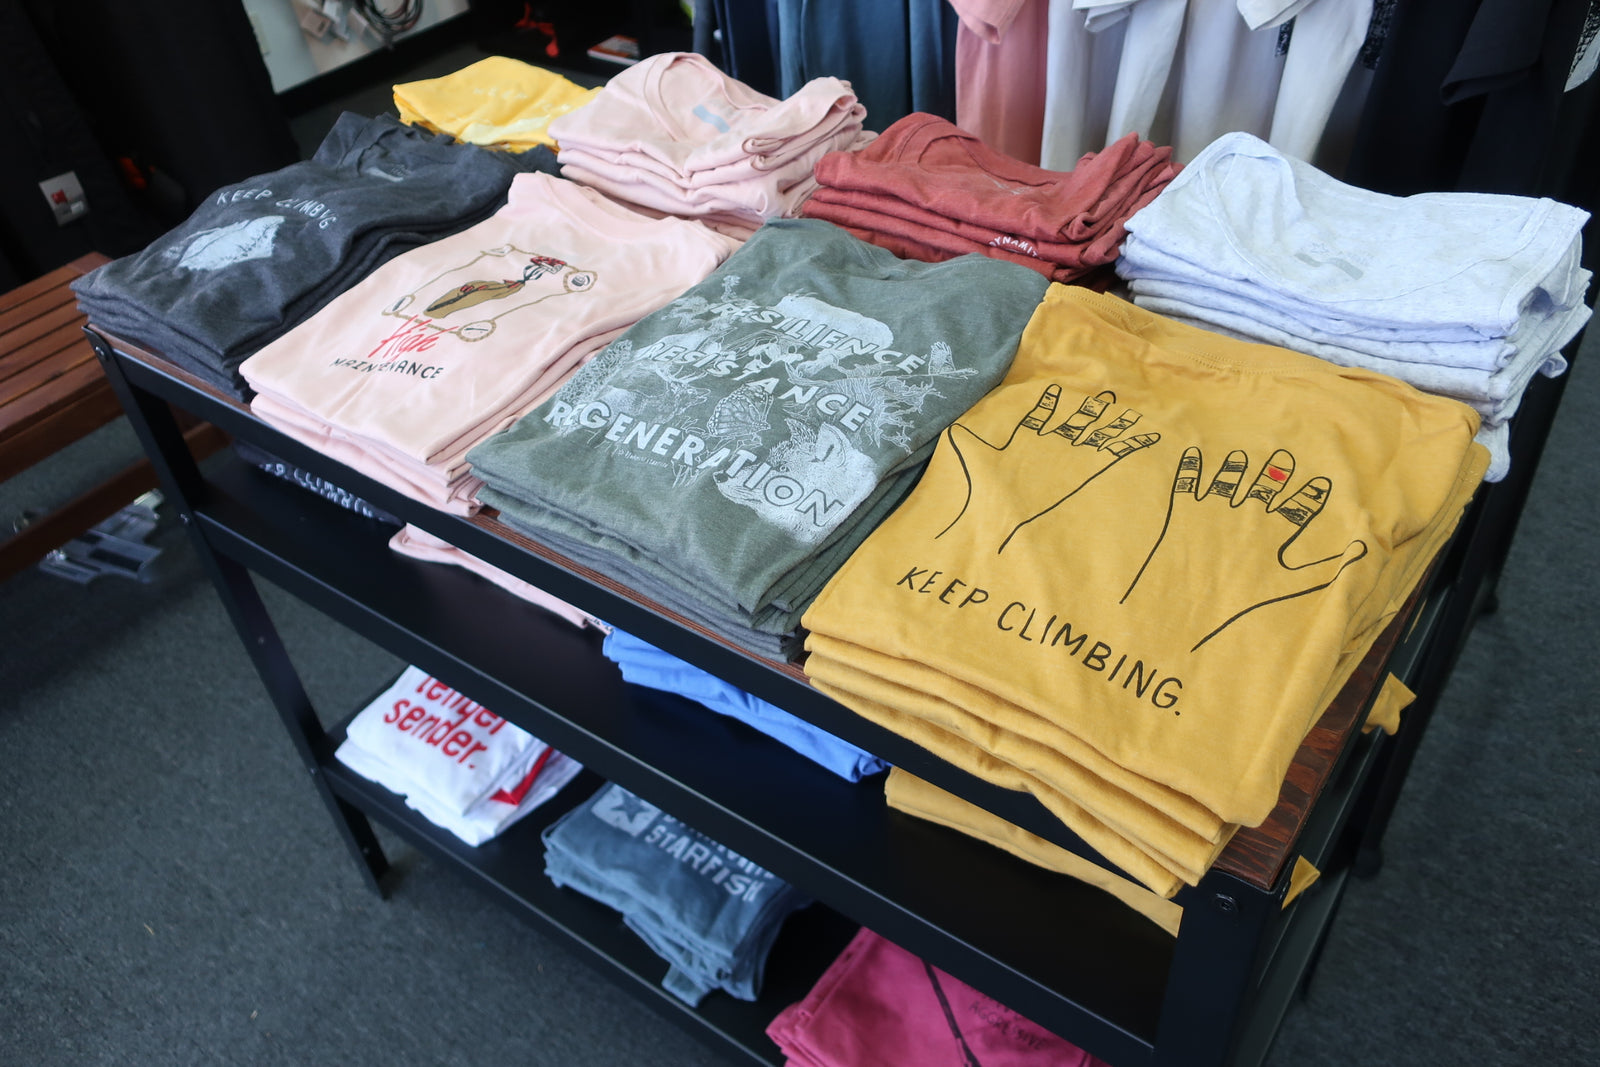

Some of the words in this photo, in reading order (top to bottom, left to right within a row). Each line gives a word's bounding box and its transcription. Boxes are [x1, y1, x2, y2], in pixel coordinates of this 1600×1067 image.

[216, 189, 273, 205] KEEP
[989, 236, 1043, 260] DYNAMIT
[329, 357, 444, 379] MAINENANCE
[709, 302, 928, 376] RESILIENCE
[639, 341, 874, 433] RESISTANCE
[543, 399, 845, 529] REGENERATION
[896, 566, 989, 608] KEEP
[997, 601, 1183, 716] CLIMBING.
[384, 698, 488, 769] sender.
[644, 824, 766, 902] STARFISH
